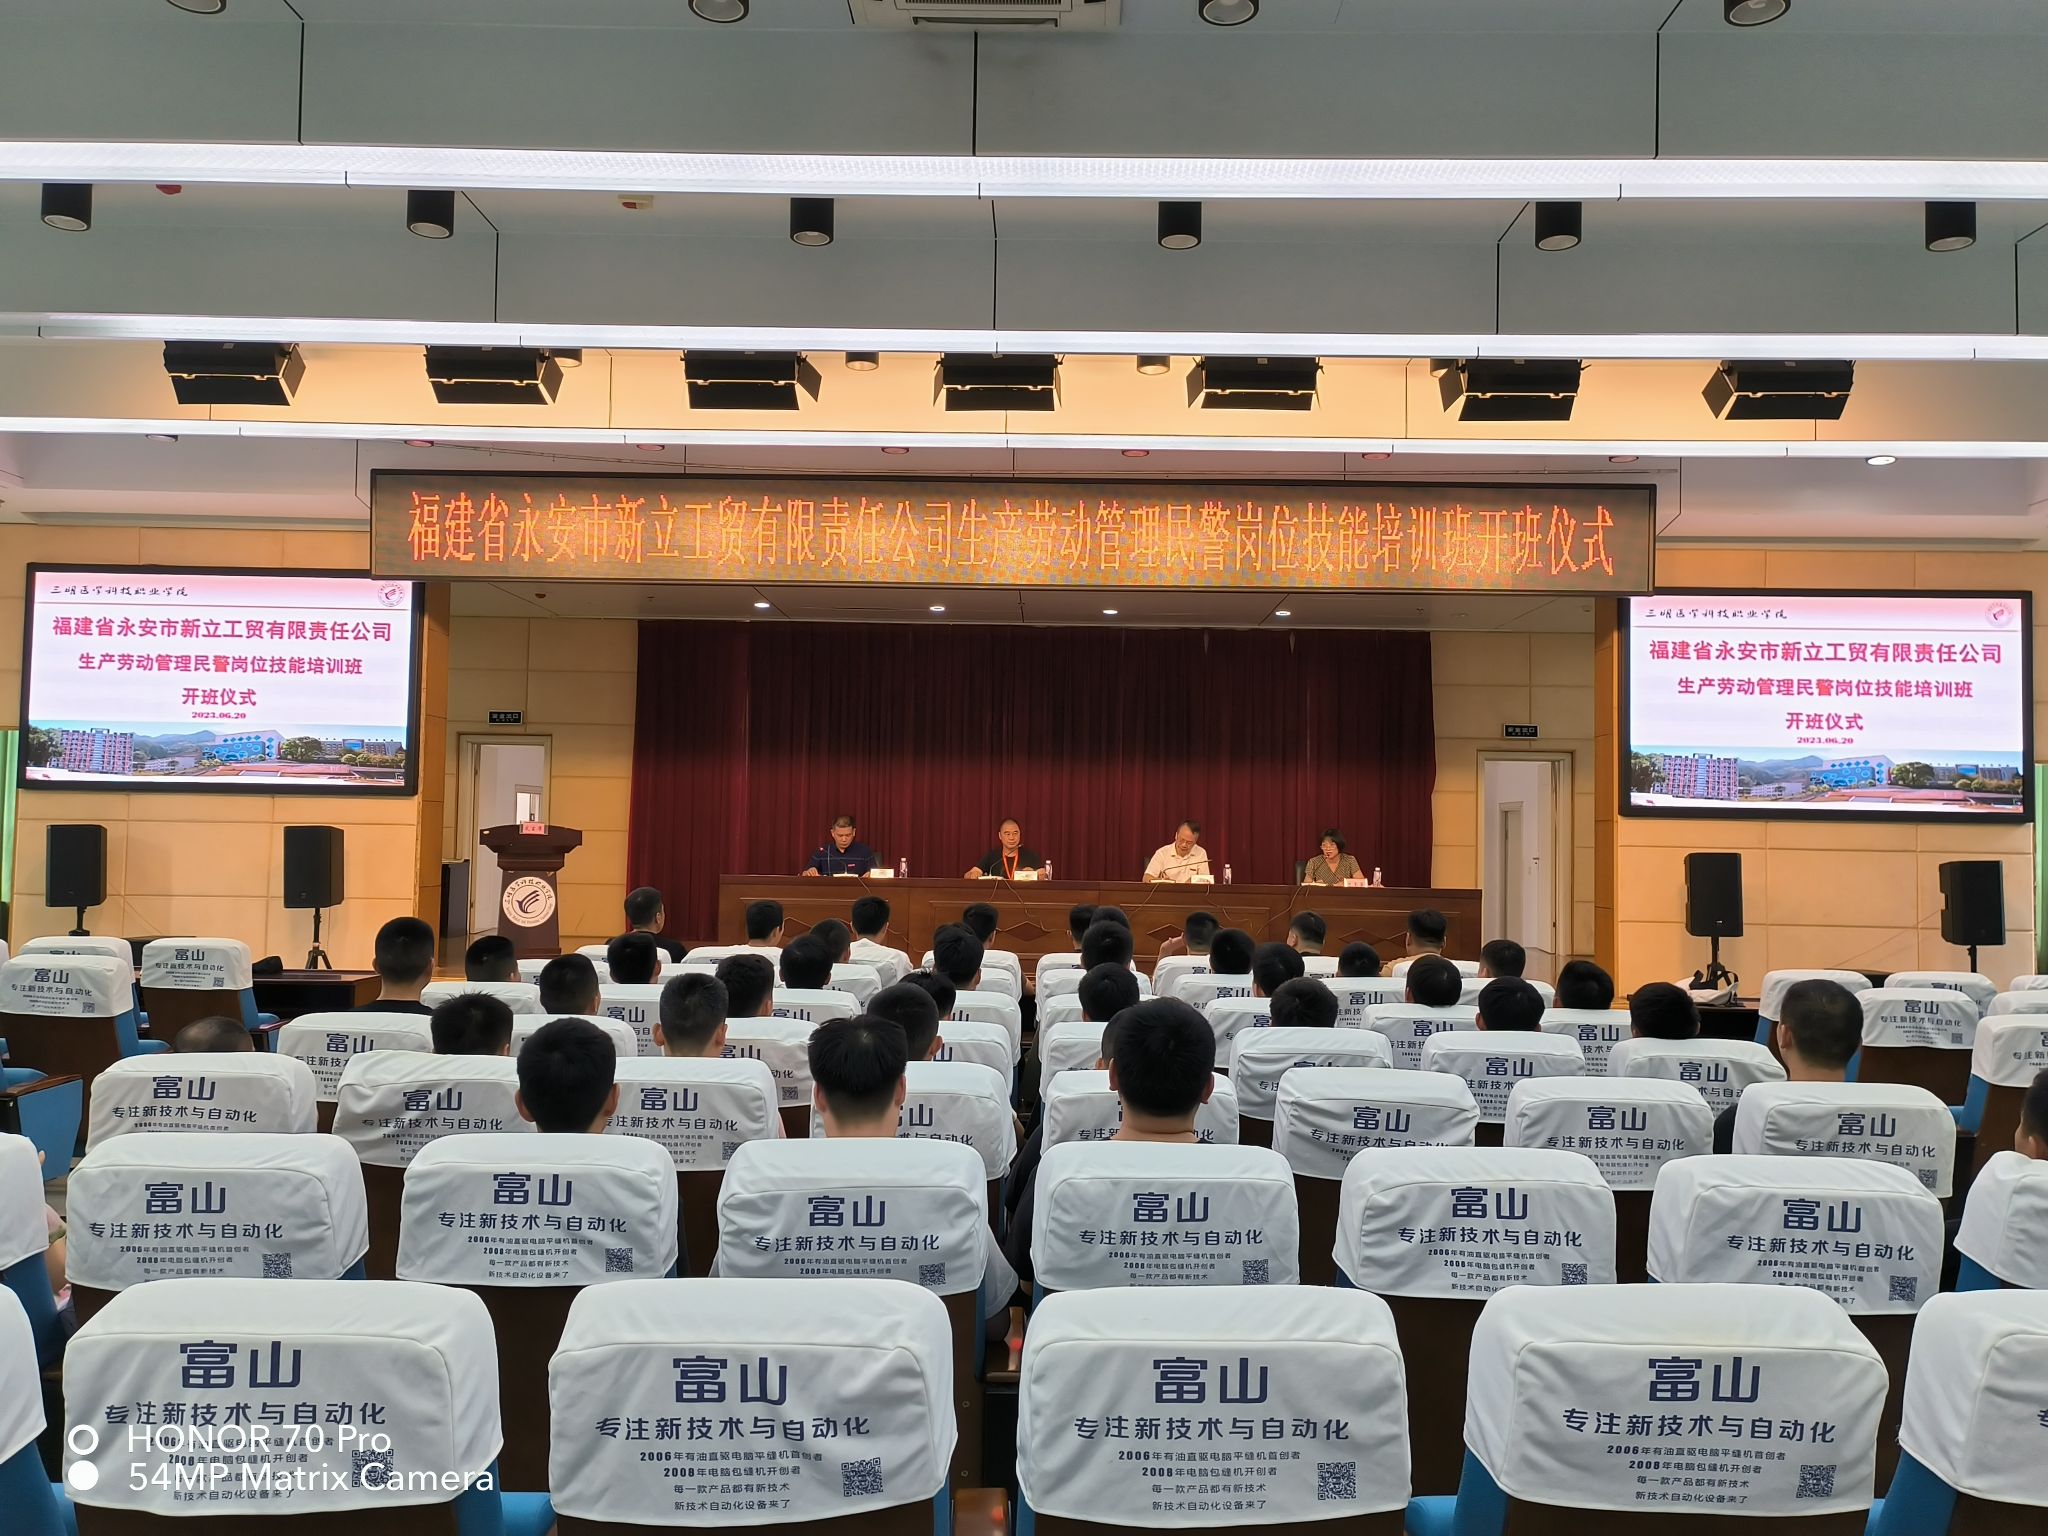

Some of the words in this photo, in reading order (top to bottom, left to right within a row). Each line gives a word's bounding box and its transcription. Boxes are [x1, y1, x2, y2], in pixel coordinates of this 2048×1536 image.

[408, 491, 1614, 576] 福建省永安市新立工贸有限责任公司生产劳动管理民警岗位技能培训班开班仪式
[52, 616, 392, 642] 福建省永安市新立工贸有限责任公司
[1649, 640, 2001, 664] 福建省永安市新立工贸有限责任公司
[78, 652, 363, 675] 生产劳动管理民警岗位技能培训班
[182, 688, 257, 706] 开班仪式
[1677, 677, 1973, 699] 生产劳动管理民警岗位技能培训班
[1786, 712, 1864, 731] 开班仪式
[175, 949, 205, 961] 富山
[34, 968, 70, 984] 富山
[1350, 991, 1384, 1005] 富山
[1904, 1000, 1940, 1015] 富山
[607, 1006, 645, 1023] 富山
[1413, 1020, 1454, 1037] 富山
[1577, 1024, 1620, 1042] 富山
[327, 1033, 374, 1053] 富山
[1485, 1057, 1533, 1077] 富山
[1679, 1062, 1727, 1083] 富山
[152, 1075, 216, 1101] 富山
[403, 1088, 462, 1111] 富山
[640, 1087, 698, 1112] 富山
[112, 1105, 257, 1123] 专注新技术与自动化
[362, 1117, 503, 1131] 专注新技术与自动化
[1353, 1106, 1411, 1133] 富山
[1587, 1106, 1648, 1131] 富山
[1838, 1112, 1896, 1137] 富山
[1546, 1137, 1685, 1151] 专注新技术与自动化
[1794, 1139, 1936, 1158] 专注新技术与自动化
[145, 1182, 226, 1215] 富山
[493, 1172, 573, 1206] 富山
[808, 1195, 886, 1227] 富山
[1133, 1191, 1209, 1223] 富山
[1451, 1186, 1528, 1220] 富山
[438, 1212, 627, 1233] 专注新技术与自动化
[1783, 1198, 1862, 1233] 富山
[89, 1222, 284, 1239] 专注新技术与自动化
[1079, 1229, 1263, 1246] 专注新技术与自动化
[1398, 1227, 1583, 1247] 专注新技术与自动化
[754, 1234, 940, 1252] 专注新技术与自动化
[1727, 1235, 1914, 1261] 专注新技术与自动化
[180, 1340, 302, 1389] 富山
[673, 1355, 789, 1405] 富山
[1153, 1357, 1269, 1404] 富山
[1648, 1356, 1760, 1403] 富山
[105, 1401, 386, 1427] 专注新技术与自动化
[595, 1416, 870, 1441] 专注新技术与自动化
[1074, 1415, 1350, 1441] 专注新技术与自动化
[1562, 1408, 1837, 1444] 专注新技术与自动化
[640, 1450, 823, 1462] 2006年有油直驱电脑平缝机首创者
[1118, 1450, 1301, 1462] 2006年有油直驱电脑平缝机首创者
[1606, 1445, 1786, 1461] 2006年有油直驱电脑平缝机首创者
[664, 1466, 801, 1478] 2008年电脑包缝机开创者
[1142, 1466, 1278, 1478] 2008年电脑包缝机开创者
[1629, 1460, 1762, 1474] 2008年电脑包缝机开创者
[673, 1482, 790, 1494] 每一款产品都有新技术
[1152, 1483, 1267, 1494] 每一款产品都有新技术
[1637, 1475, 1750, 1489] 每一款产品都有新技术
[674, 1499, 791, 1511] 新技术自动化设备来了
[1152, 1499, 1267, 1511] 新技术自动化设备来了
[1635, 1490, 1748, 1504] 新技术自动化设备来了
